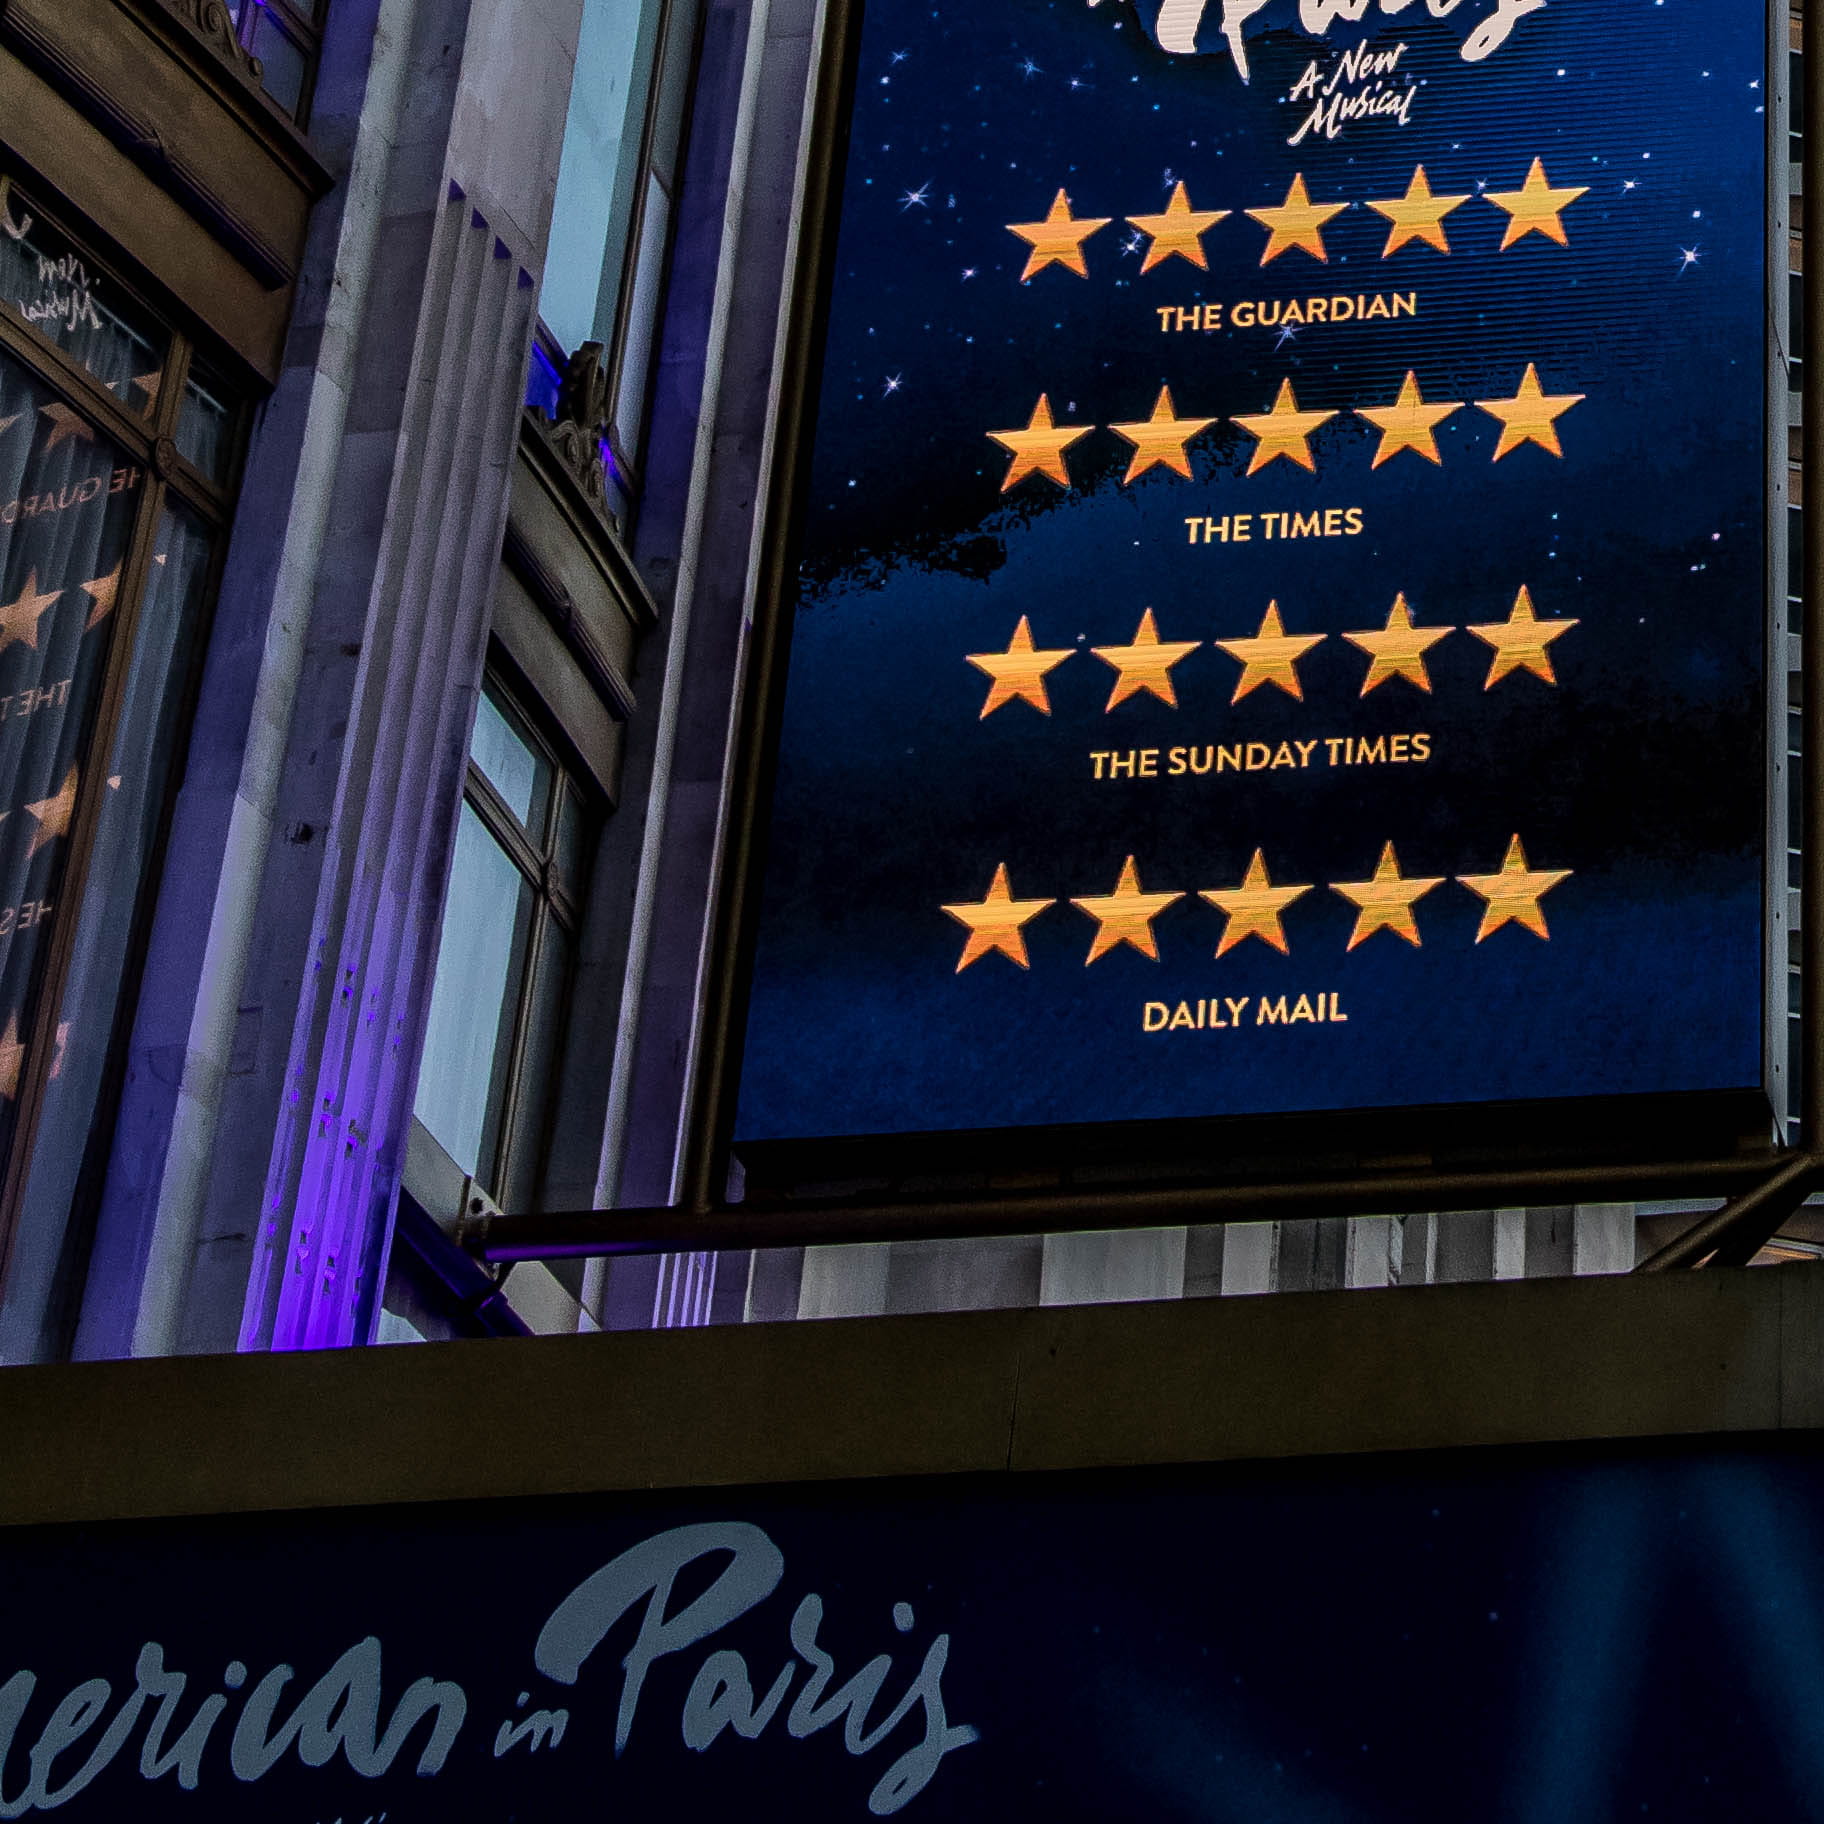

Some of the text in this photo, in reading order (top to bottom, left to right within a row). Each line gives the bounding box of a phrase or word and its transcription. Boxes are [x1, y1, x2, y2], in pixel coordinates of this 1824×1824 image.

[1289, 38, 1409, 102] A New
[1286, 83, 1418, 146] Musical
[1156, 292, 1418, 333] THE GUARDIAN
[1184, 507, 1365, 545] THE TIMES
[1089, 733, 1432, 780] THE SUNDAY TIMES
[1142, 991, 1349, 1033] DAILY MAIL
[493, 1691, 569, 1757] in
[534, 1521, 981, 1816] Paris
